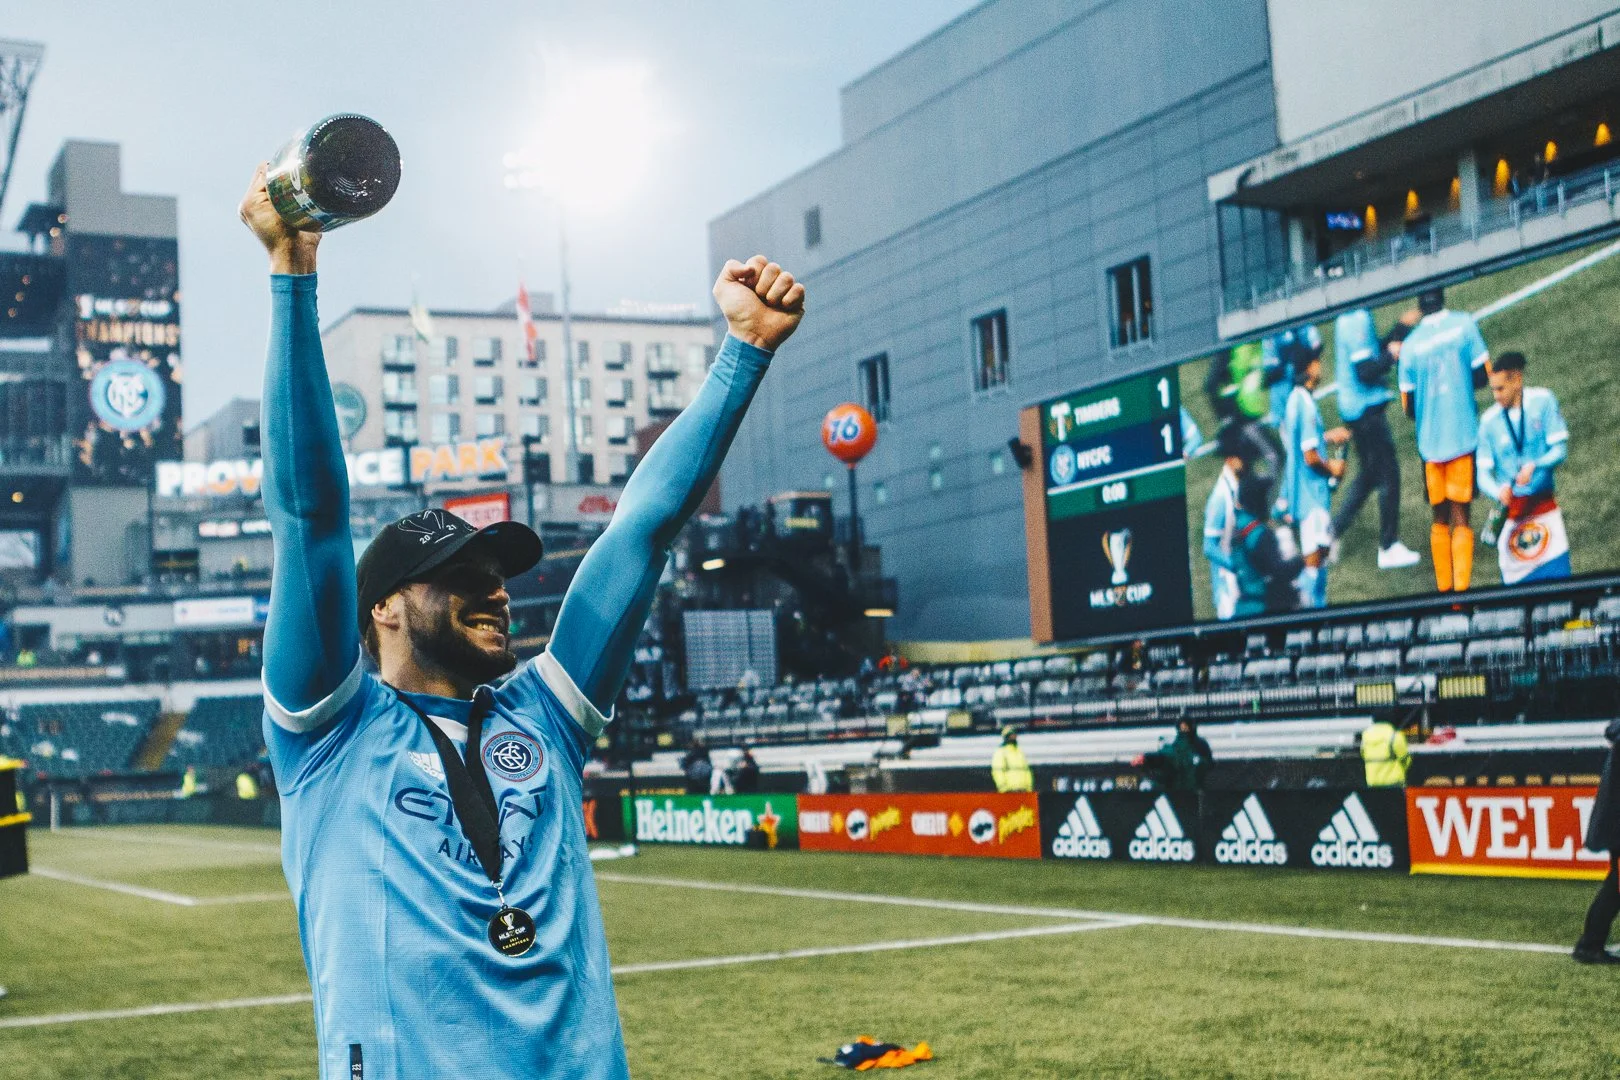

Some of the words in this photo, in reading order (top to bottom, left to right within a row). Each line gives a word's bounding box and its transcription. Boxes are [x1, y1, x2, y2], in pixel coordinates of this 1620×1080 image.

[1157, 377, 1170, 408] 1
[829, 413, 859, 443] 76
[1161, 423, 1173, 454] 1
[410, 439, 508, 482] PARK
[419, 534, 431, 544] 20
[1052, 835, 1112, 859] adidas
[1129, 836, 1195, 862] adidas
[1215, 839, 1288, 865] adidas
[1311, 840, 1394, 868] adidas
